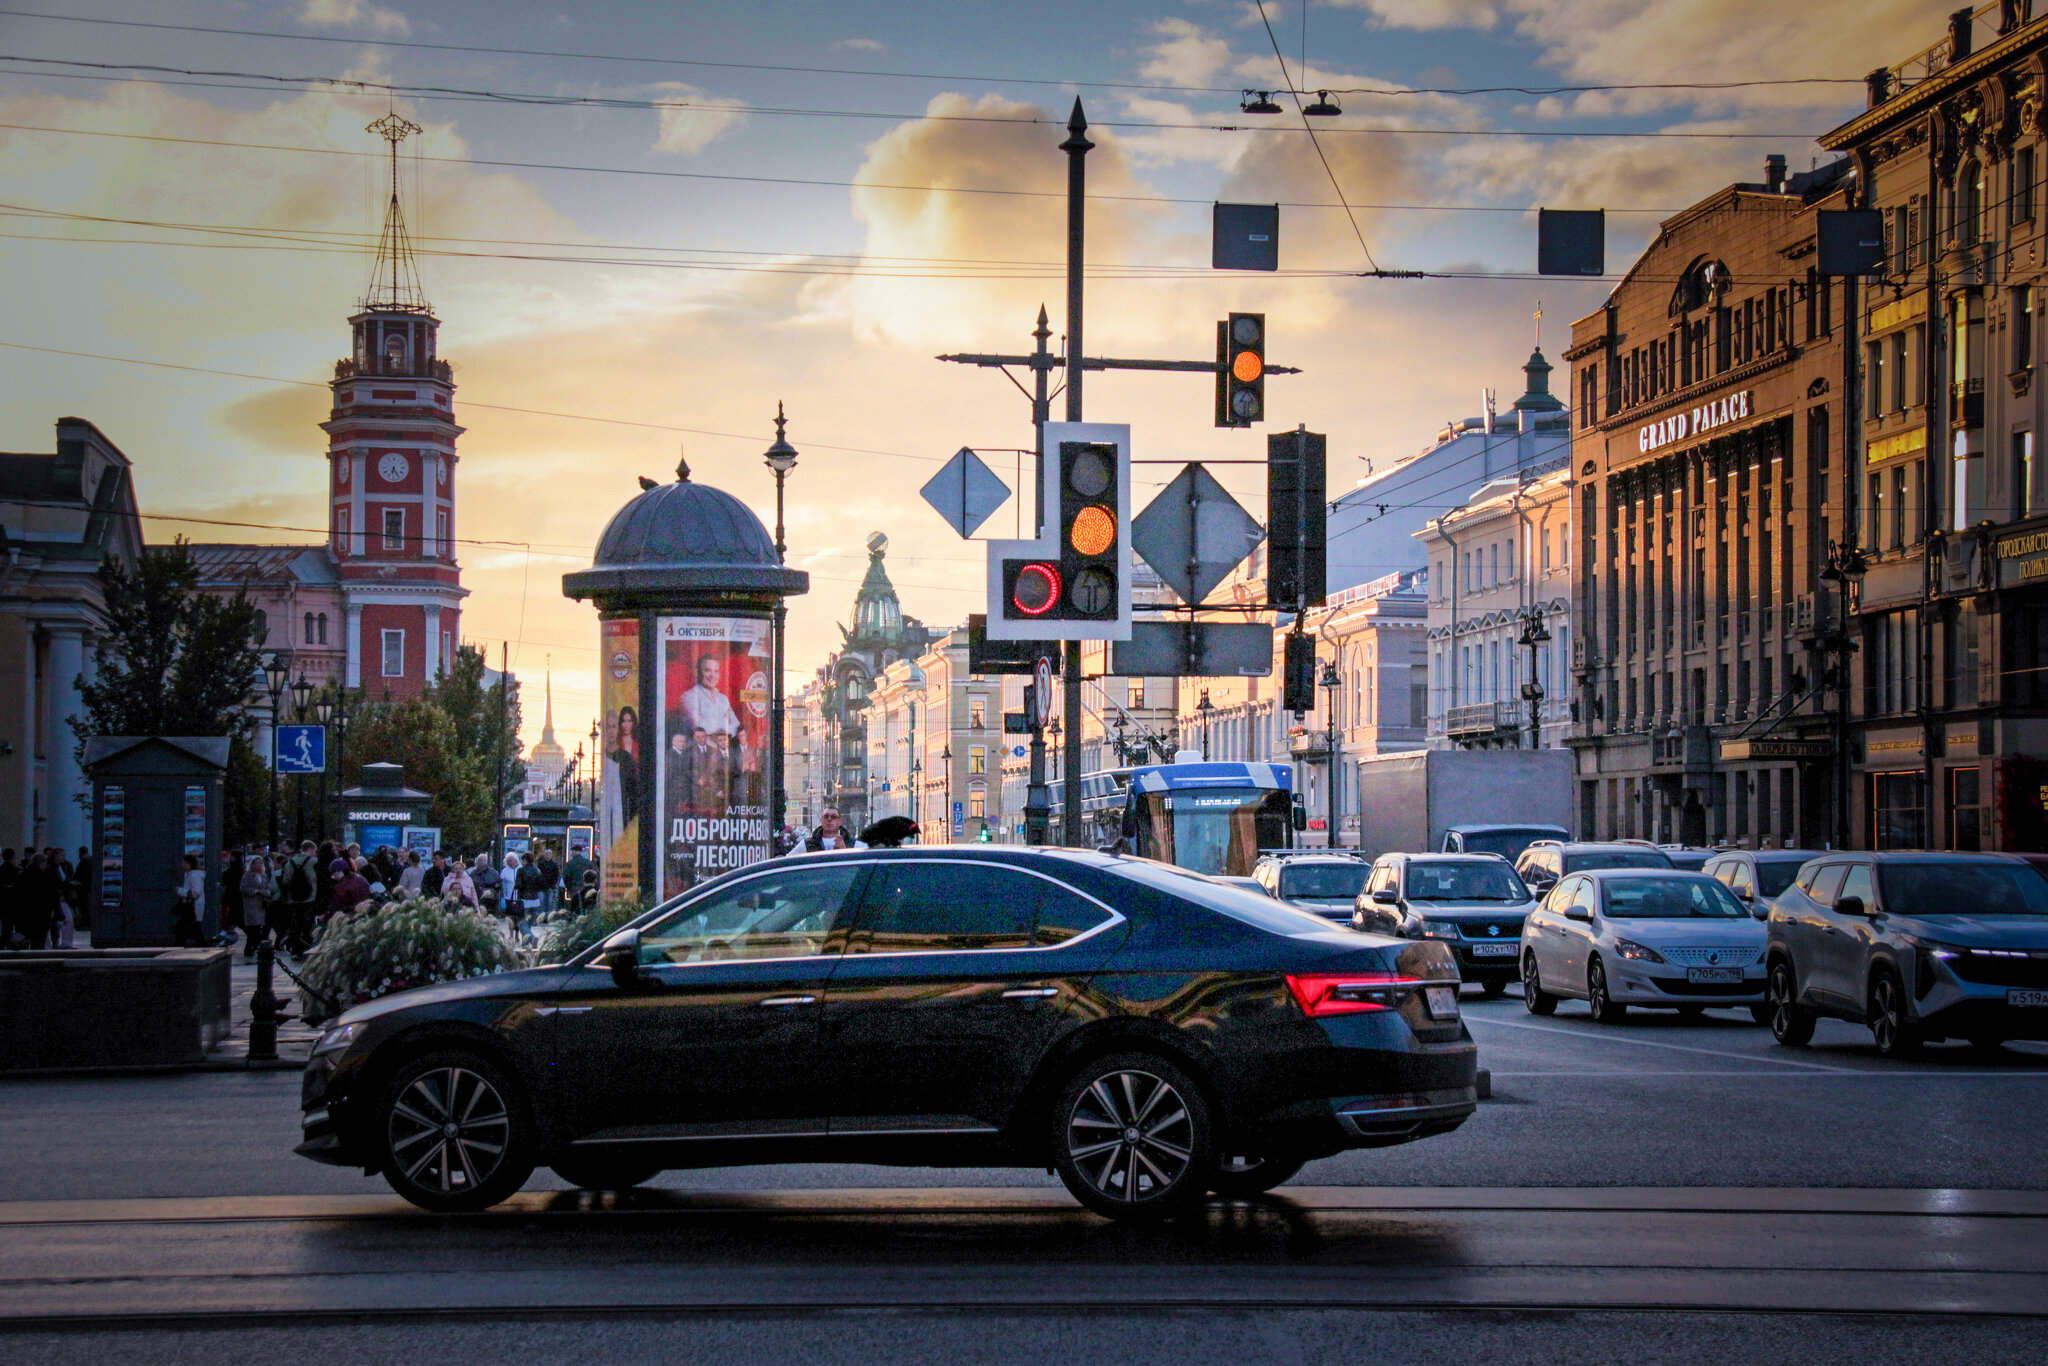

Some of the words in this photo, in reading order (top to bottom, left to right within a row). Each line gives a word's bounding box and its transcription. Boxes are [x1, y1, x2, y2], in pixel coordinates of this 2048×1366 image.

[1639, 413, 1688, 453] GRAND
[1692, 390, 1749, 435] PALACE
[1997, 535, 2035, 559] ГОРОДСКАЯ
[665, 622, 675, 636] 4
[678, 627, 725, 637] ОКТЯБРЯ
[348, 811, 411, 821] ЭКСКУРСИИ
